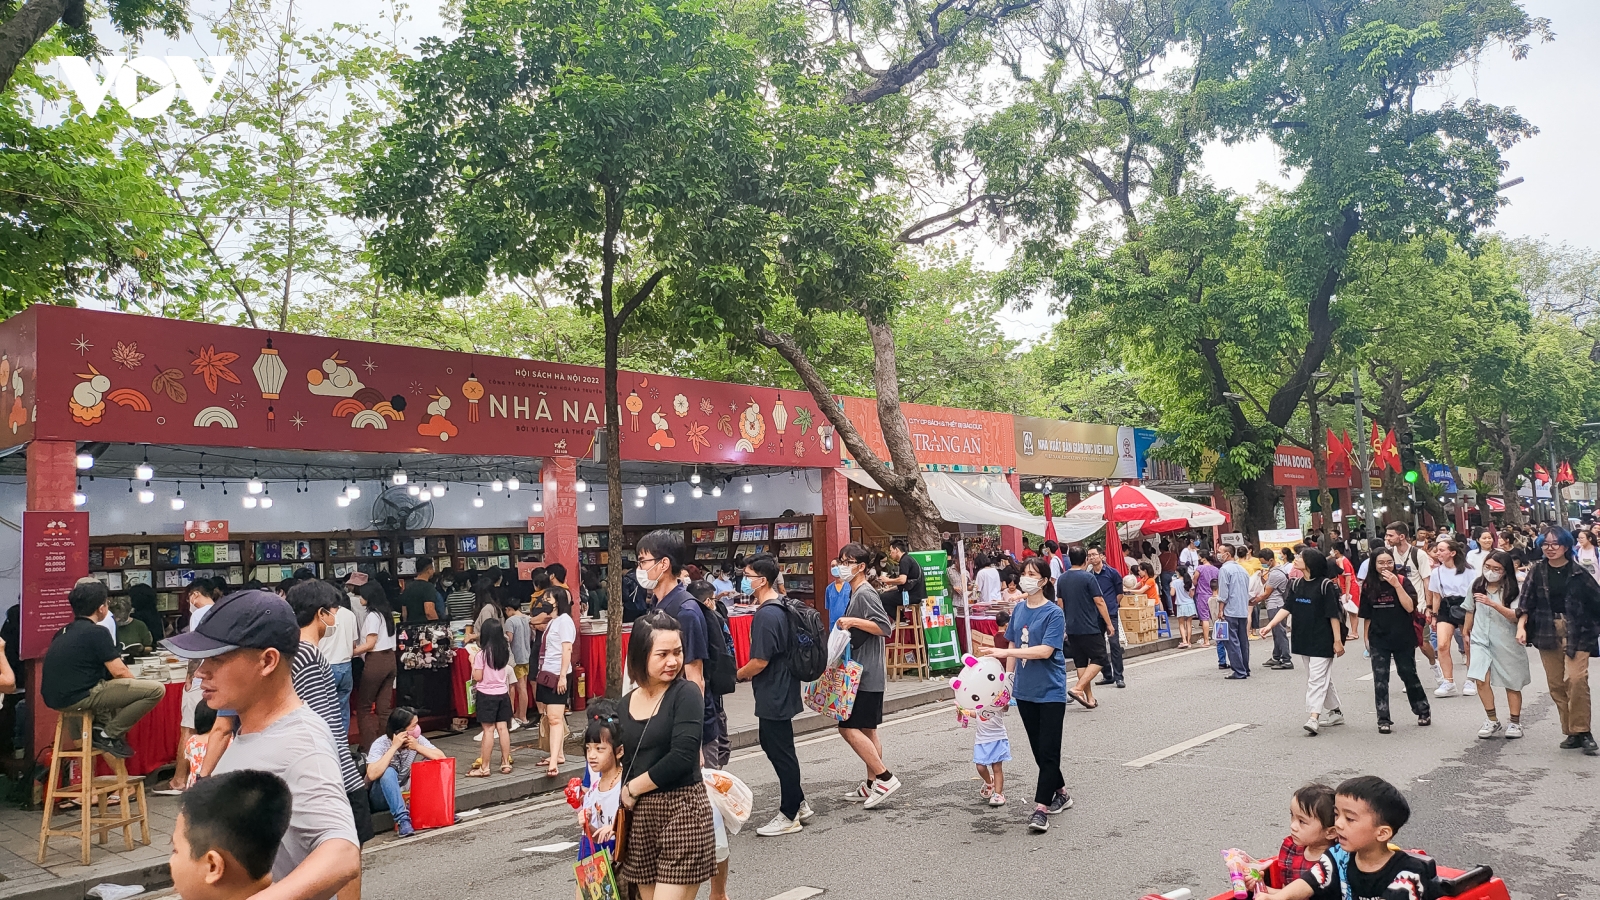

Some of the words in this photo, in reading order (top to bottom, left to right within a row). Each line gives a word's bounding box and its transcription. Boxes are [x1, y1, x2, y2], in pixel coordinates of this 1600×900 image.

[515, 368, 530, 379] HỘI
[532, 370, 552, 379] SÁCH
[554, 372, 565, 380] HÀ
[567, 373, 581, 384] NỘI
[582, 376, 600, 384] 2022
[489, 391, 552, 421] NHÃ
[541, 426, 559, 434] SÁCH
[913, 430, 960, 453] TRÀNG
[962, 437, 981, 454] AN
[1037, 438, 1049, 451] NHÀ
[1049, 437, 1062, 452] XUẤT
[1062, 439, 1073, 453] BẢN
[1093, 442, 1103, 457] VIỆT
[1103, 444, 1114, 455] NAM
[1273, 453, 1292, 468] ALPHA
[1292, 455, 1312, 469] BOOKS
